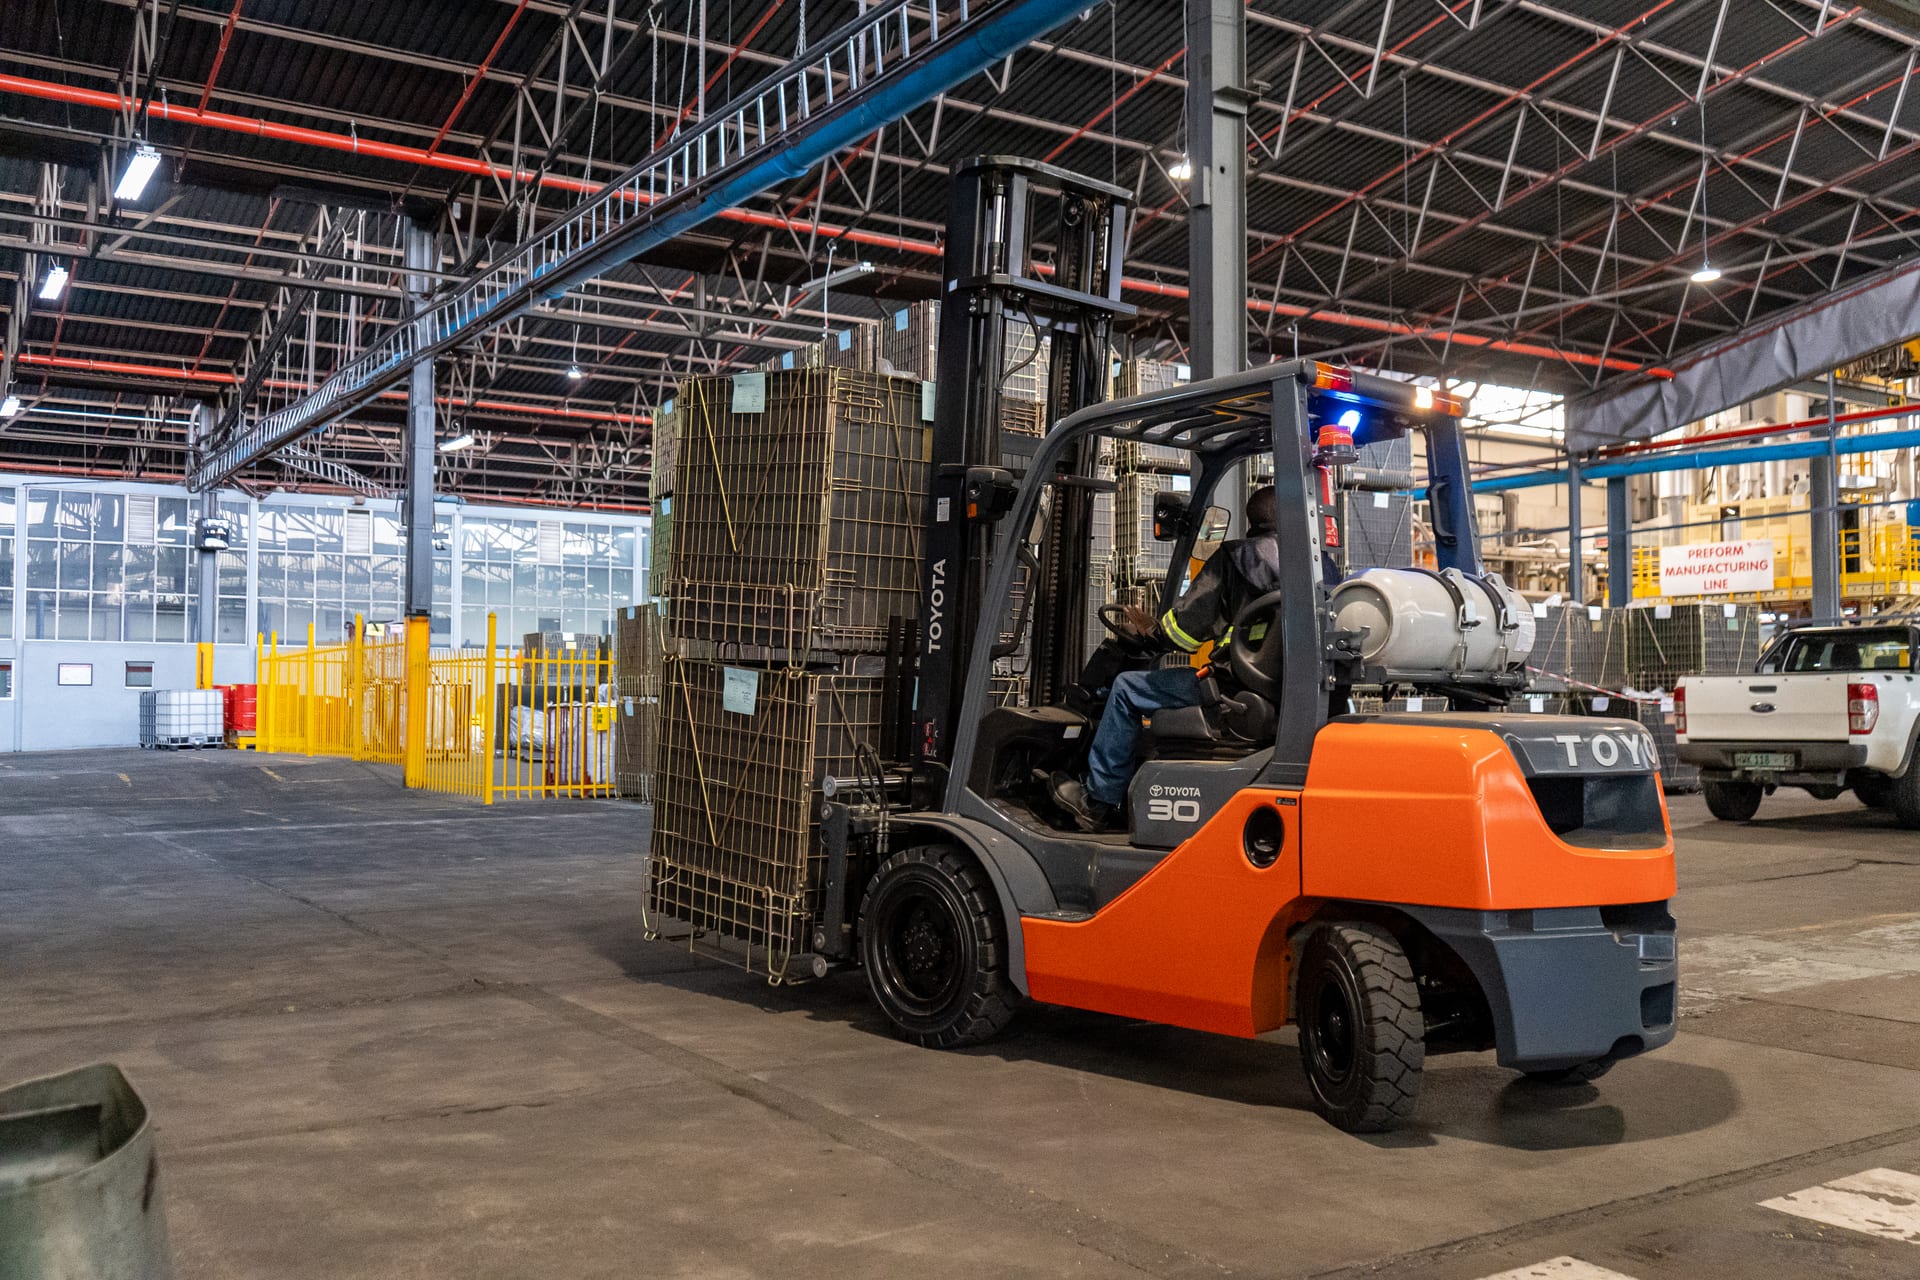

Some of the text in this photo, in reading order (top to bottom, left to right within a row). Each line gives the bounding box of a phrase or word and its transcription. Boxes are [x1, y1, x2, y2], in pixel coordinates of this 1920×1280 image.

[1688, 546, 1744, 559] PREFORM
[1665, 559, 1769, 577] MANUFACTURING
[1703, 579, 1729, 591] LINE
[928, 558, 946, 654] TOYOTA
[1164, 786, 1201, 797] TOYOTA
[1147, 799, 1200, 823] 30
